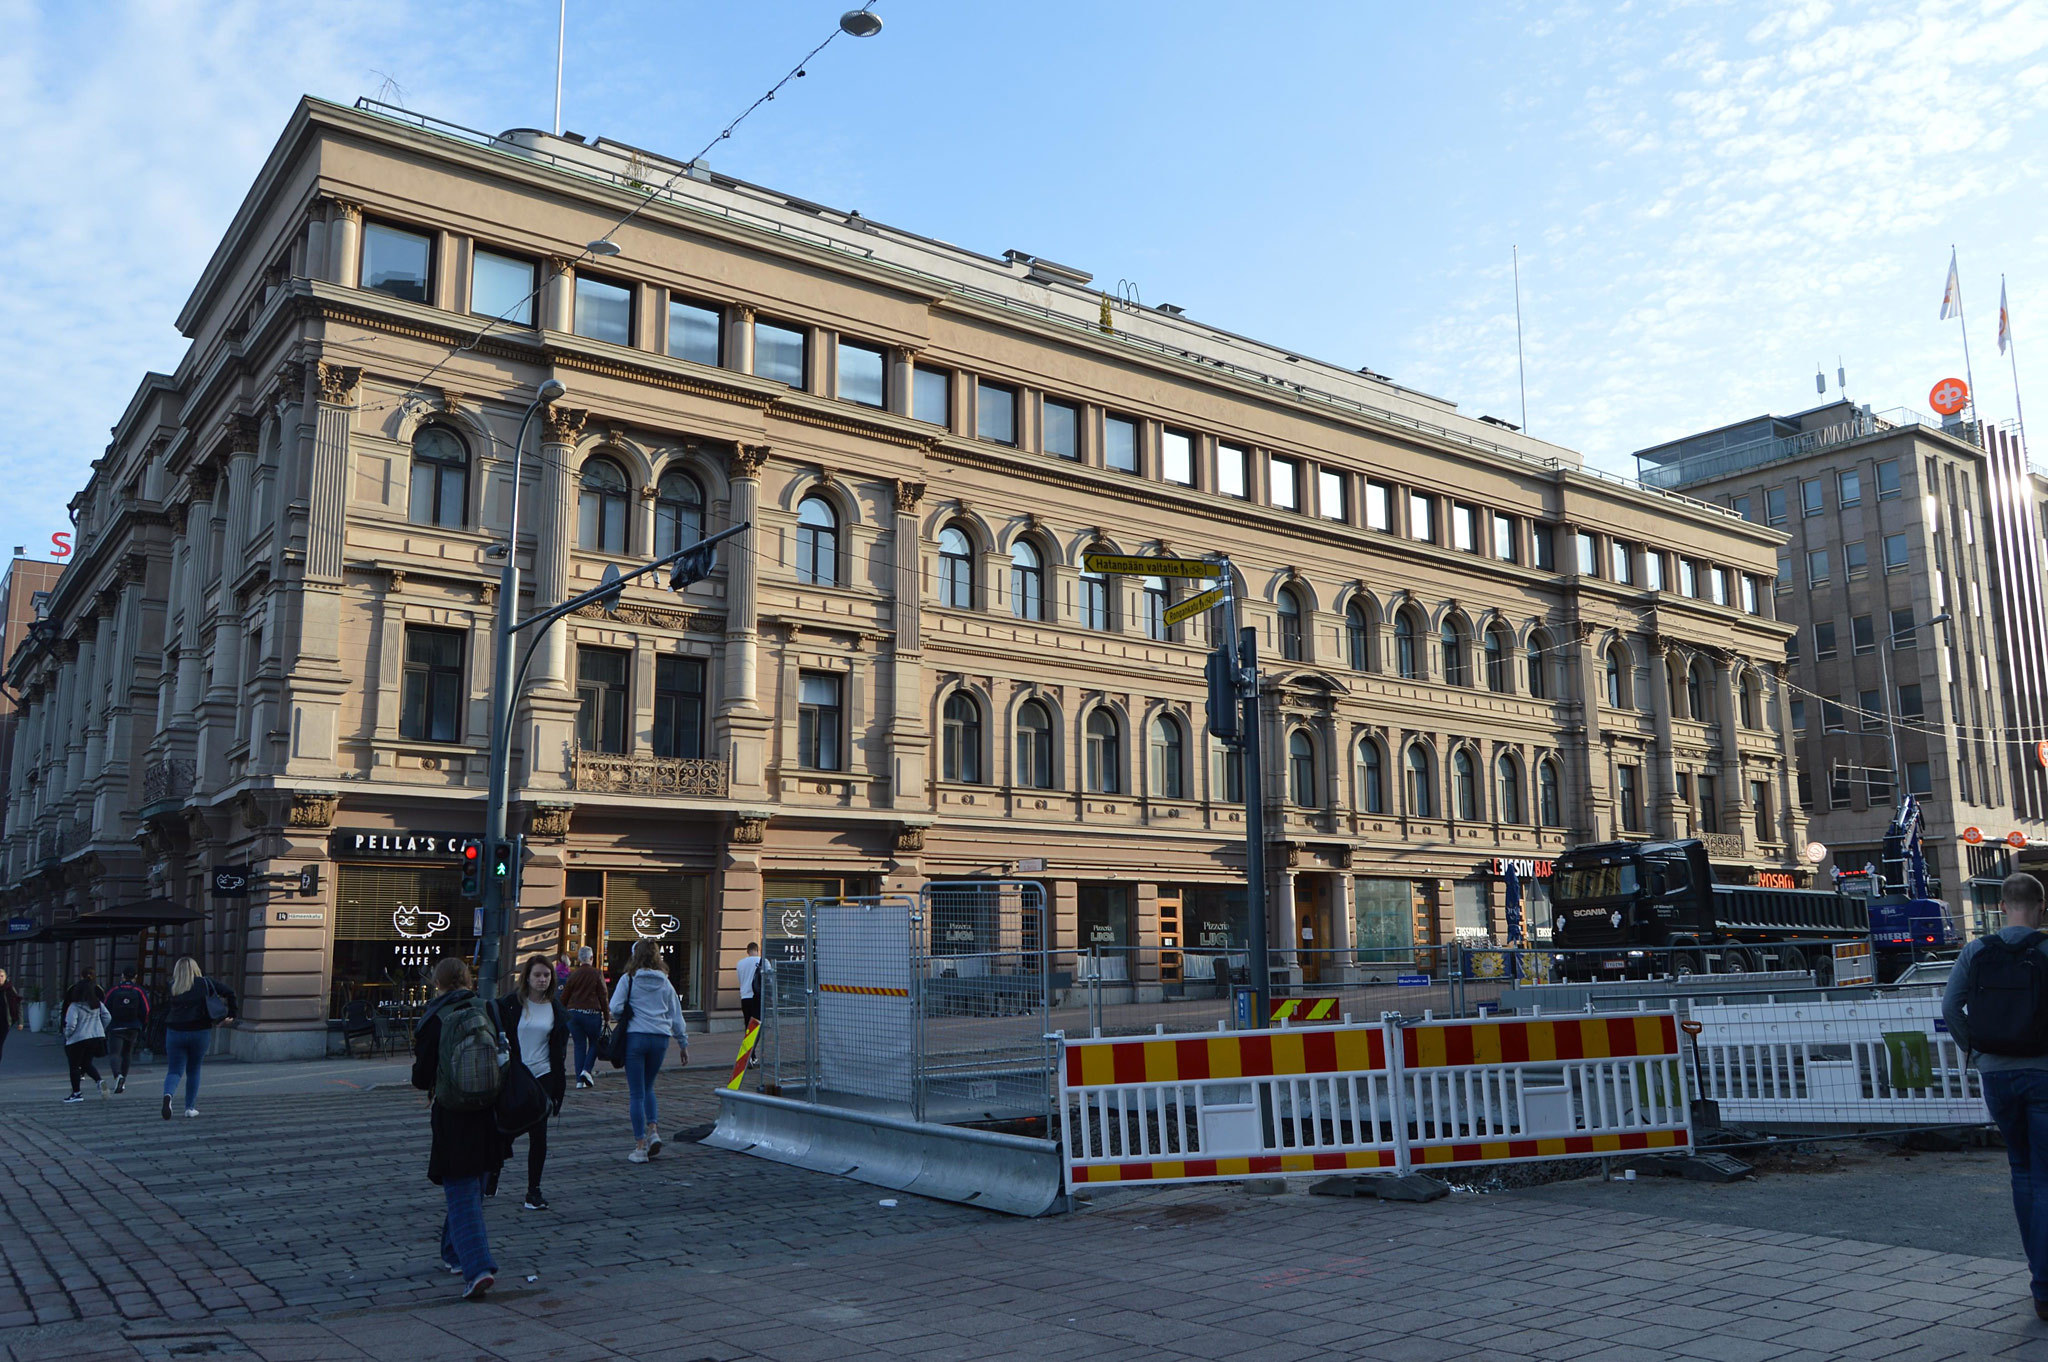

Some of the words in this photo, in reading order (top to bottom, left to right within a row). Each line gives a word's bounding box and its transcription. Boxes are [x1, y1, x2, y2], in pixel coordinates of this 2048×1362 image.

[50, 532, 71, 557] S
[1096, 558, 1144, 573] Hatanpään
[1147, 563, 1179, 574] valtatie
[355, 834, 435, 851] PELLA'S
[1573, 908, 1607, 917] SCANIA
[395, 946, 441, 954] PELLA'S
[401, 957, 429, 966] CAFE
